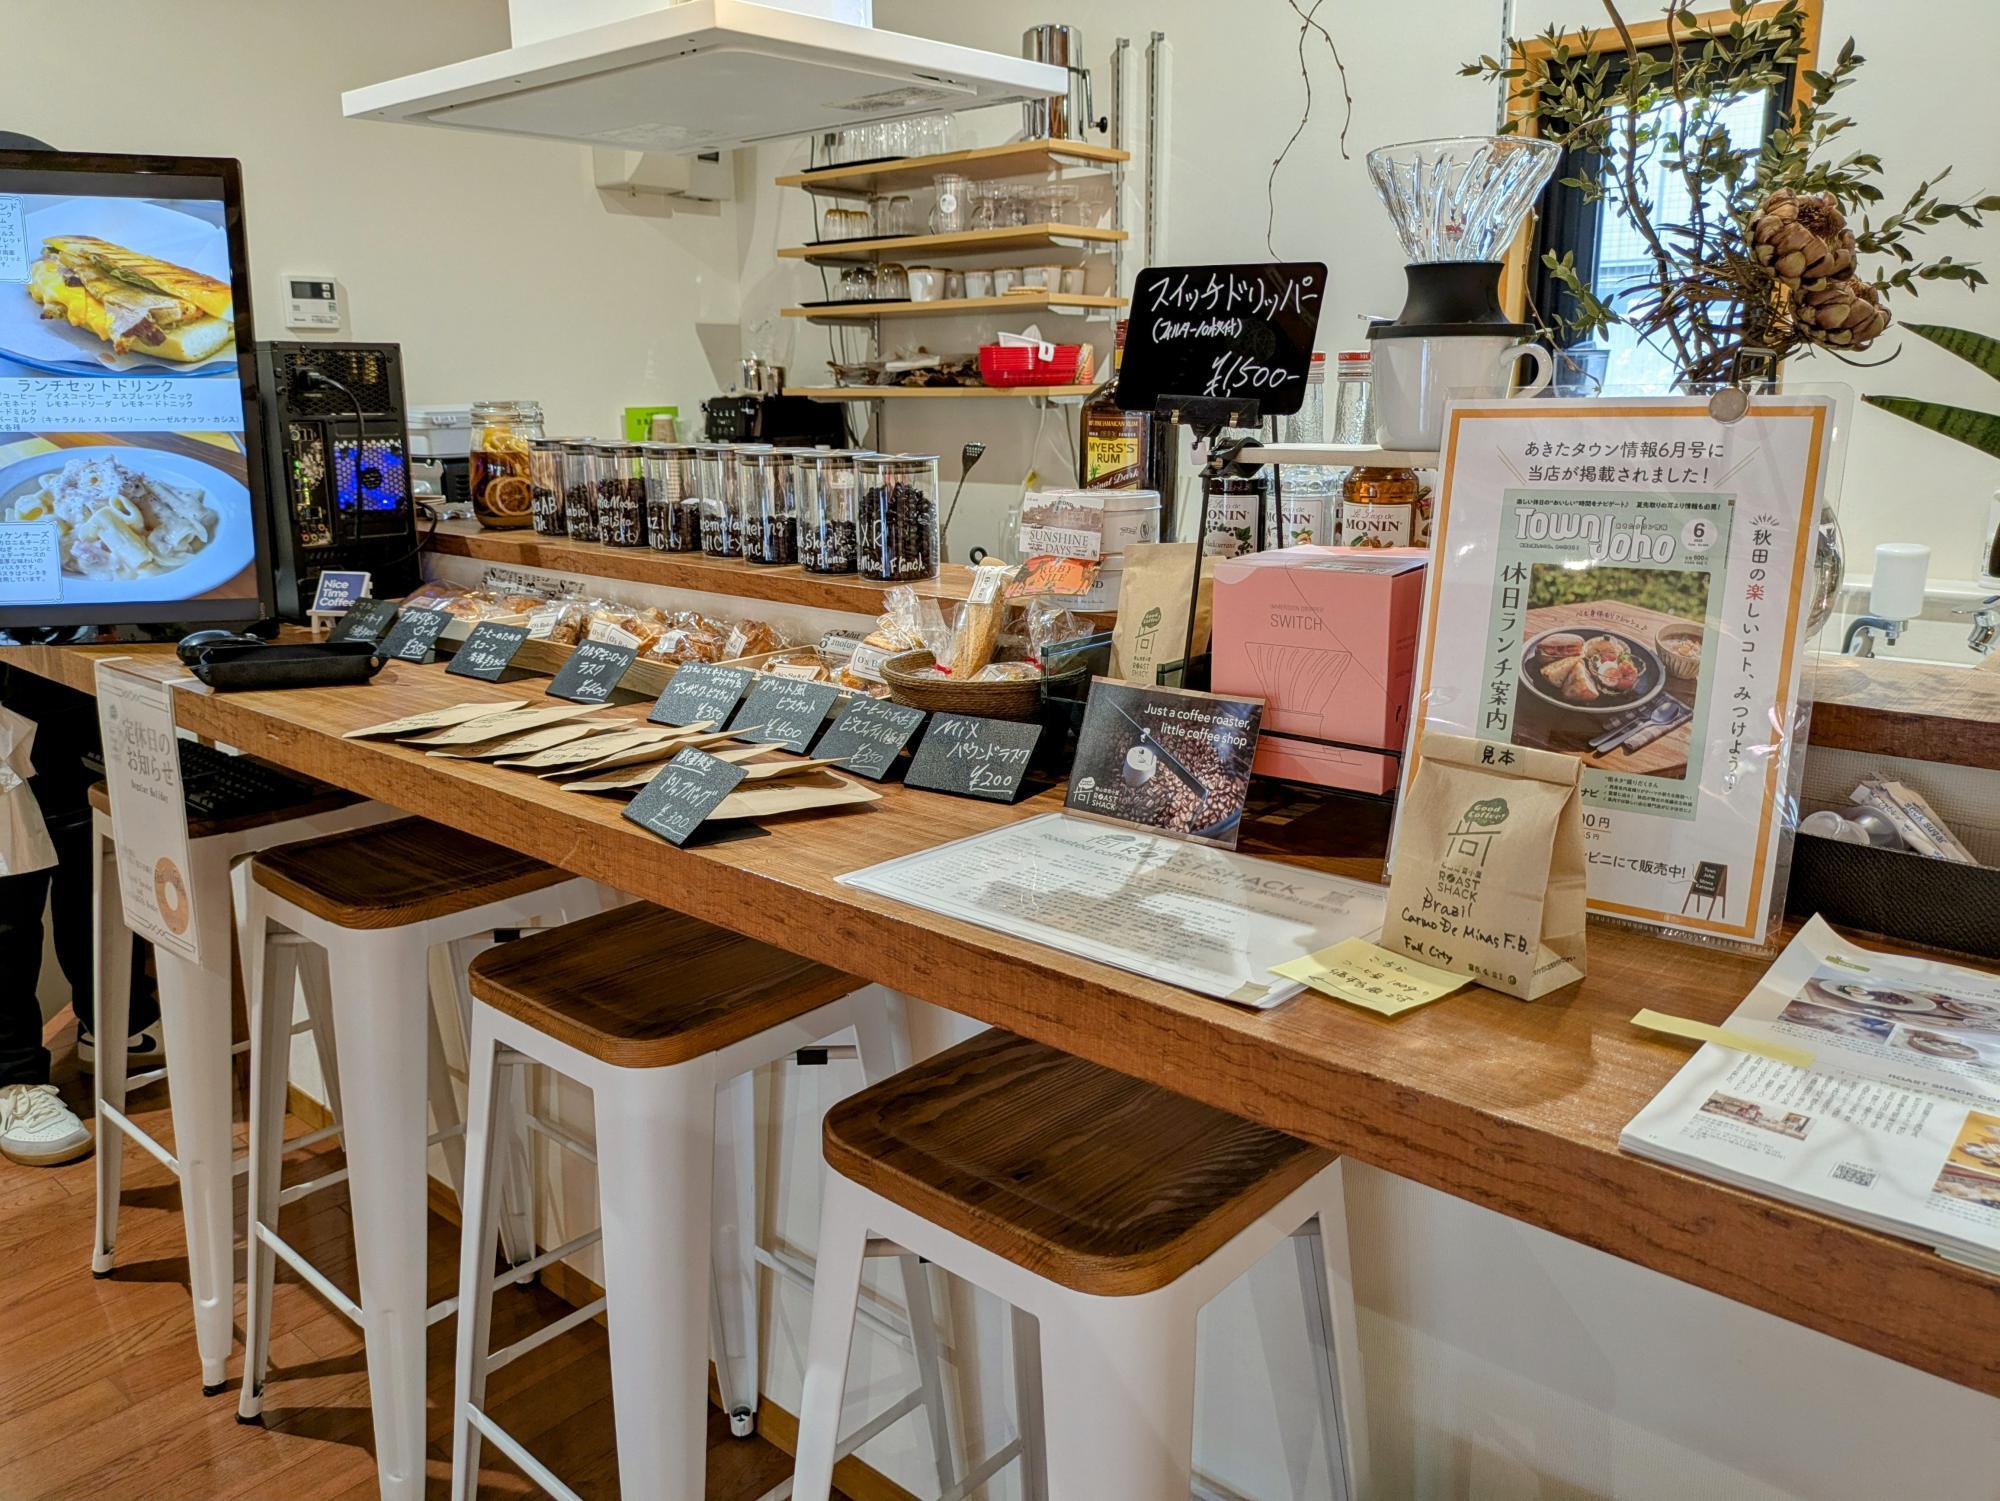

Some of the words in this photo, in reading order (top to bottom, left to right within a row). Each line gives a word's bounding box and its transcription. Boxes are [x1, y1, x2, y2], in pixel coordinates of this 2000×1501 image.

[1148, 272, 1319, 322] スイッチドリッパー
[17, 379, 175, 393] ランチセットドリンク
[1089, 442, 1136, 454] MYERS'S
[1524, 439, 1725, 459] あきたタウン情報6月号に
[1097, 453, 1121, 464] RUM
[1208, 509, 1248, 521] ONIN
[1345, 518, 1401, 532] MONIN
[1692, 522, 1706, 538] 6
[1029, 528, 1089, 547] SUNSHINE
[1045, 543, 1073, 556] DAYS
[1039, 564, 1077, 575] RUBY
[322, 588, 350, 598] Time
[323, 579, 350, 590] Nice
[319, 597, 356, 608] Coffee
[1270, 613, 1323, 632] SWITCH
[1485, 560, 1529, 732] 休日ランチ案内
[577, 661, 605, 676] ラスク
[1144, 703, 1168, 717] Just
[1168, 708, 1176, 718] a
[1177, 708, 1211, 724] coffee
[1211, 715, 1252, 730] roaster,
[121, 716, 171, 757] 定休日の
[765, 717, 803, 739] ¥400
[1160, 721, 1186, 737] little
[1186, 728, 1221, 743] coffee
[1221, 733, 1249, 750] shop
[850, 743, 885, 765] ¥350
[1481, 744, 1517, 767] 見本
[126, 746, 175, 788] お知らせ
[968, 764, 1014, 789] ¥200
[1091, 799, 1117, 811] SHACK
[1093, 791, 1119, 803] ROAST
[1473, 803, 1502, 814] Good
[1584, 850, 1687, 879] ビニにて販売中！
[1438, 870, 1481, 891] ROAST
[1437, 881, 1478, 903] SHACK
[1421, 886, 1473, 919] Brazil
[1429, 945, 1454, 965] City
